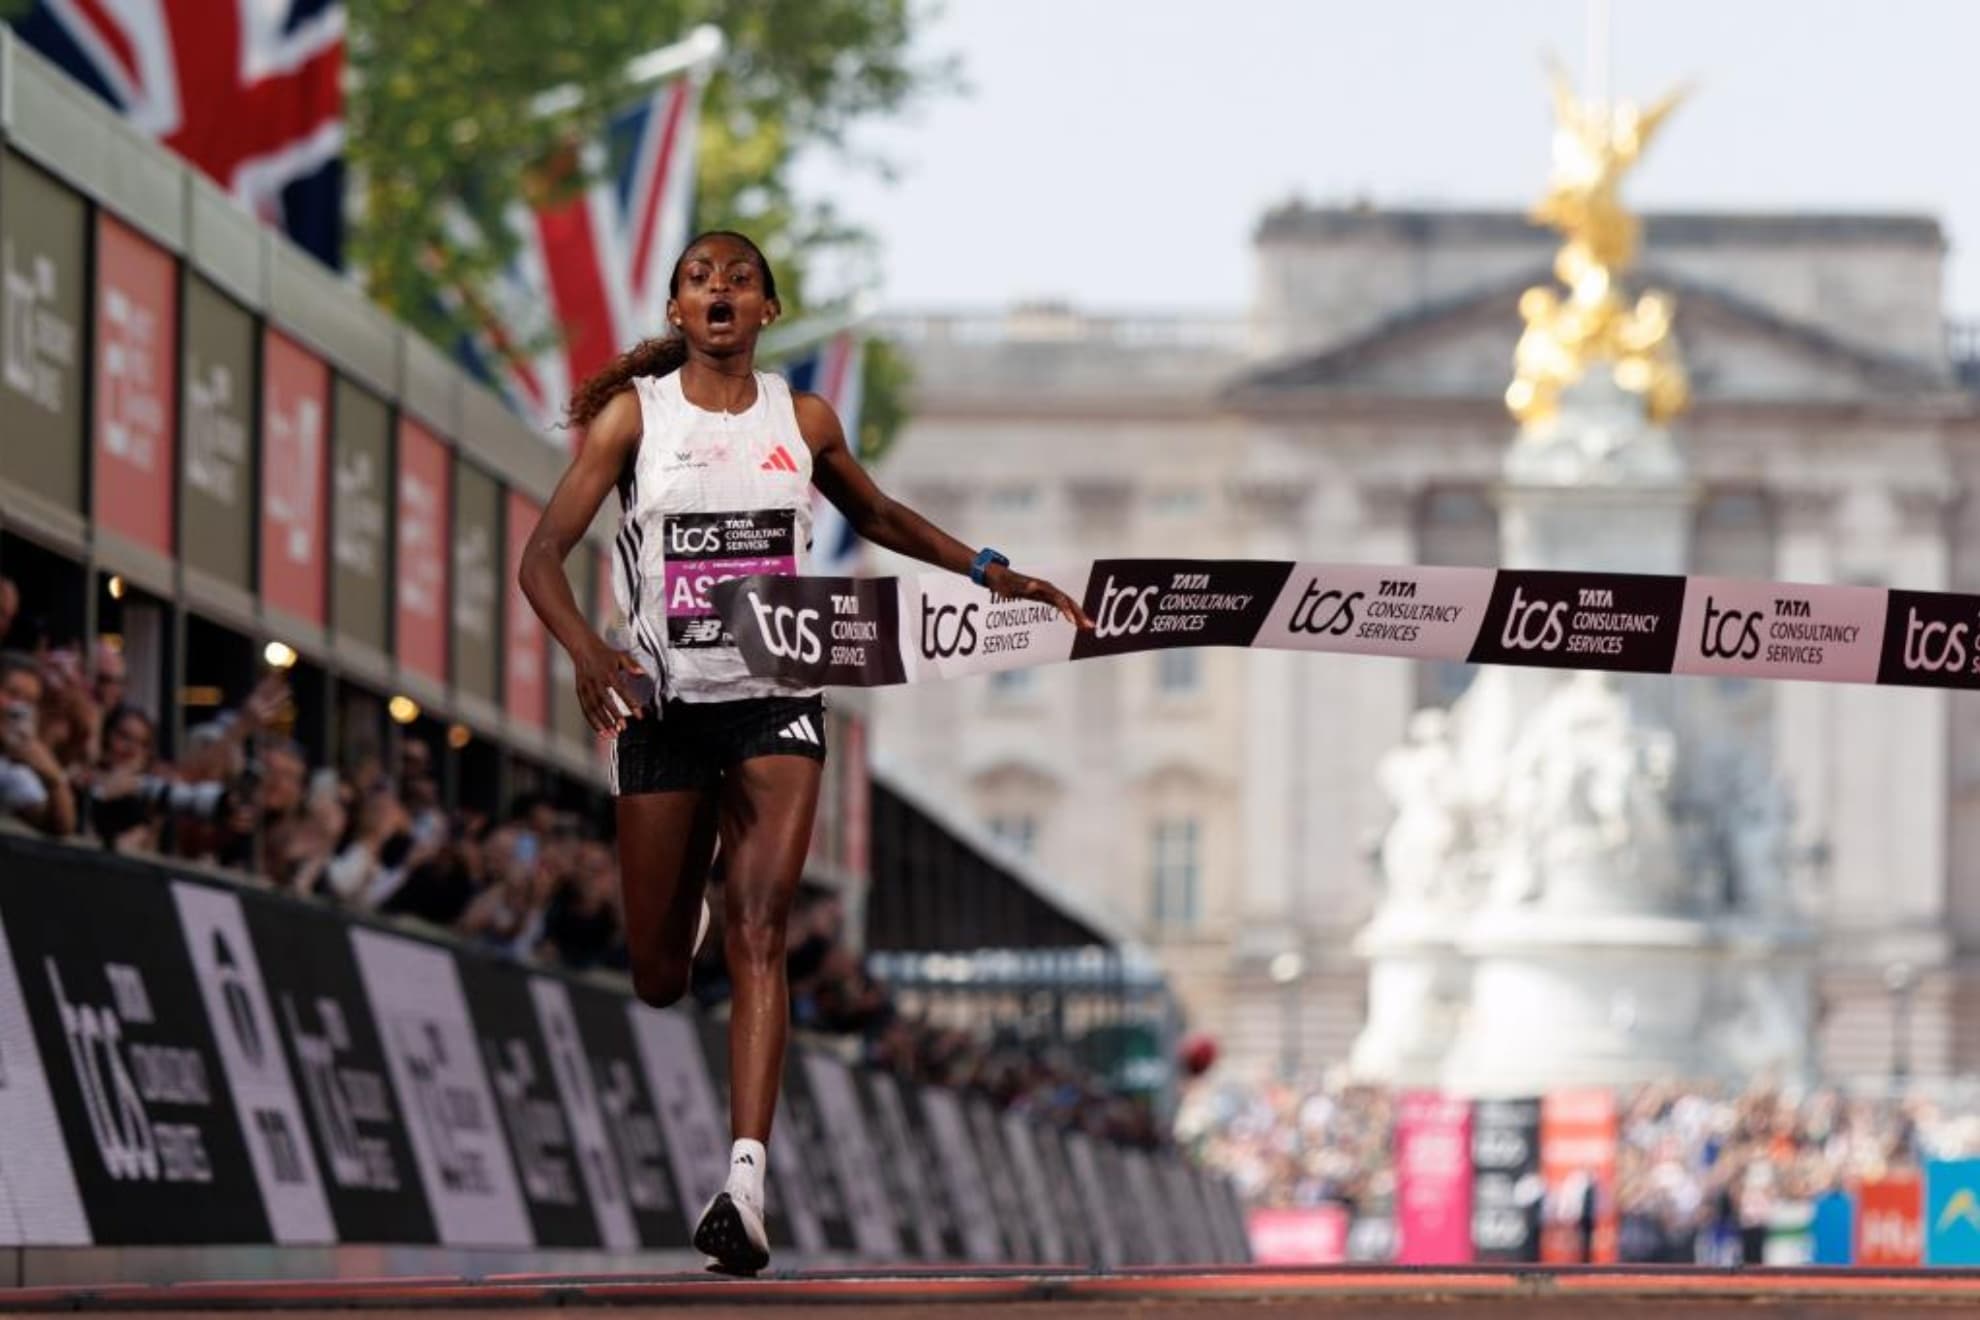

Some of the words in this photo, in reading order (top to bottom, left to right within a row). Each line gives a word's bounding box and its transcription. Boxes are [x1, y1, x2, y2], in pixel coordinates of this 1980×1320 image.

[724, 520, 754, 529] TATA
[724, 528, 786, 541] CONSULTANCY
[671, 522, 721, 552] tcs
[725, 540, 770, 551] SERVICES
[1171, 574, 1210, 590] TATA
[1379, 580, 1416, 598] TATA
[1095, 575, 1159, 638] tcs
[1159, 594, 1252, 611] CONSULTANCY
[1288, 577, 1364, 636] tcs
[1578, 589, 1613, 607] TATA
[1366, 601, 1463, 623] CONSULTANCY
[1501, 587, 1568, 650] tcs
[1774, 600, 1811, 618] TATA
[747, 591, 821, 664] tcs
[921, 592, 979, 660] tcs
[1150, 615, 1207, 632] SERVICES
[1356, 622, 1420, 642] SERVICES
[1572, 611, 1659, 633] CONSULTANCY
[1700, 596, 1763, 659] tcs
[982, 630, 1031, 655] SERVICES
[1769, 622, 1860, 644] CONSULTANCY
[1904, 606, 1968, 672] tcs
[1566, 636, 1623, 654] SERVICES
[1766, 644, 1823, 665] SERVICES
